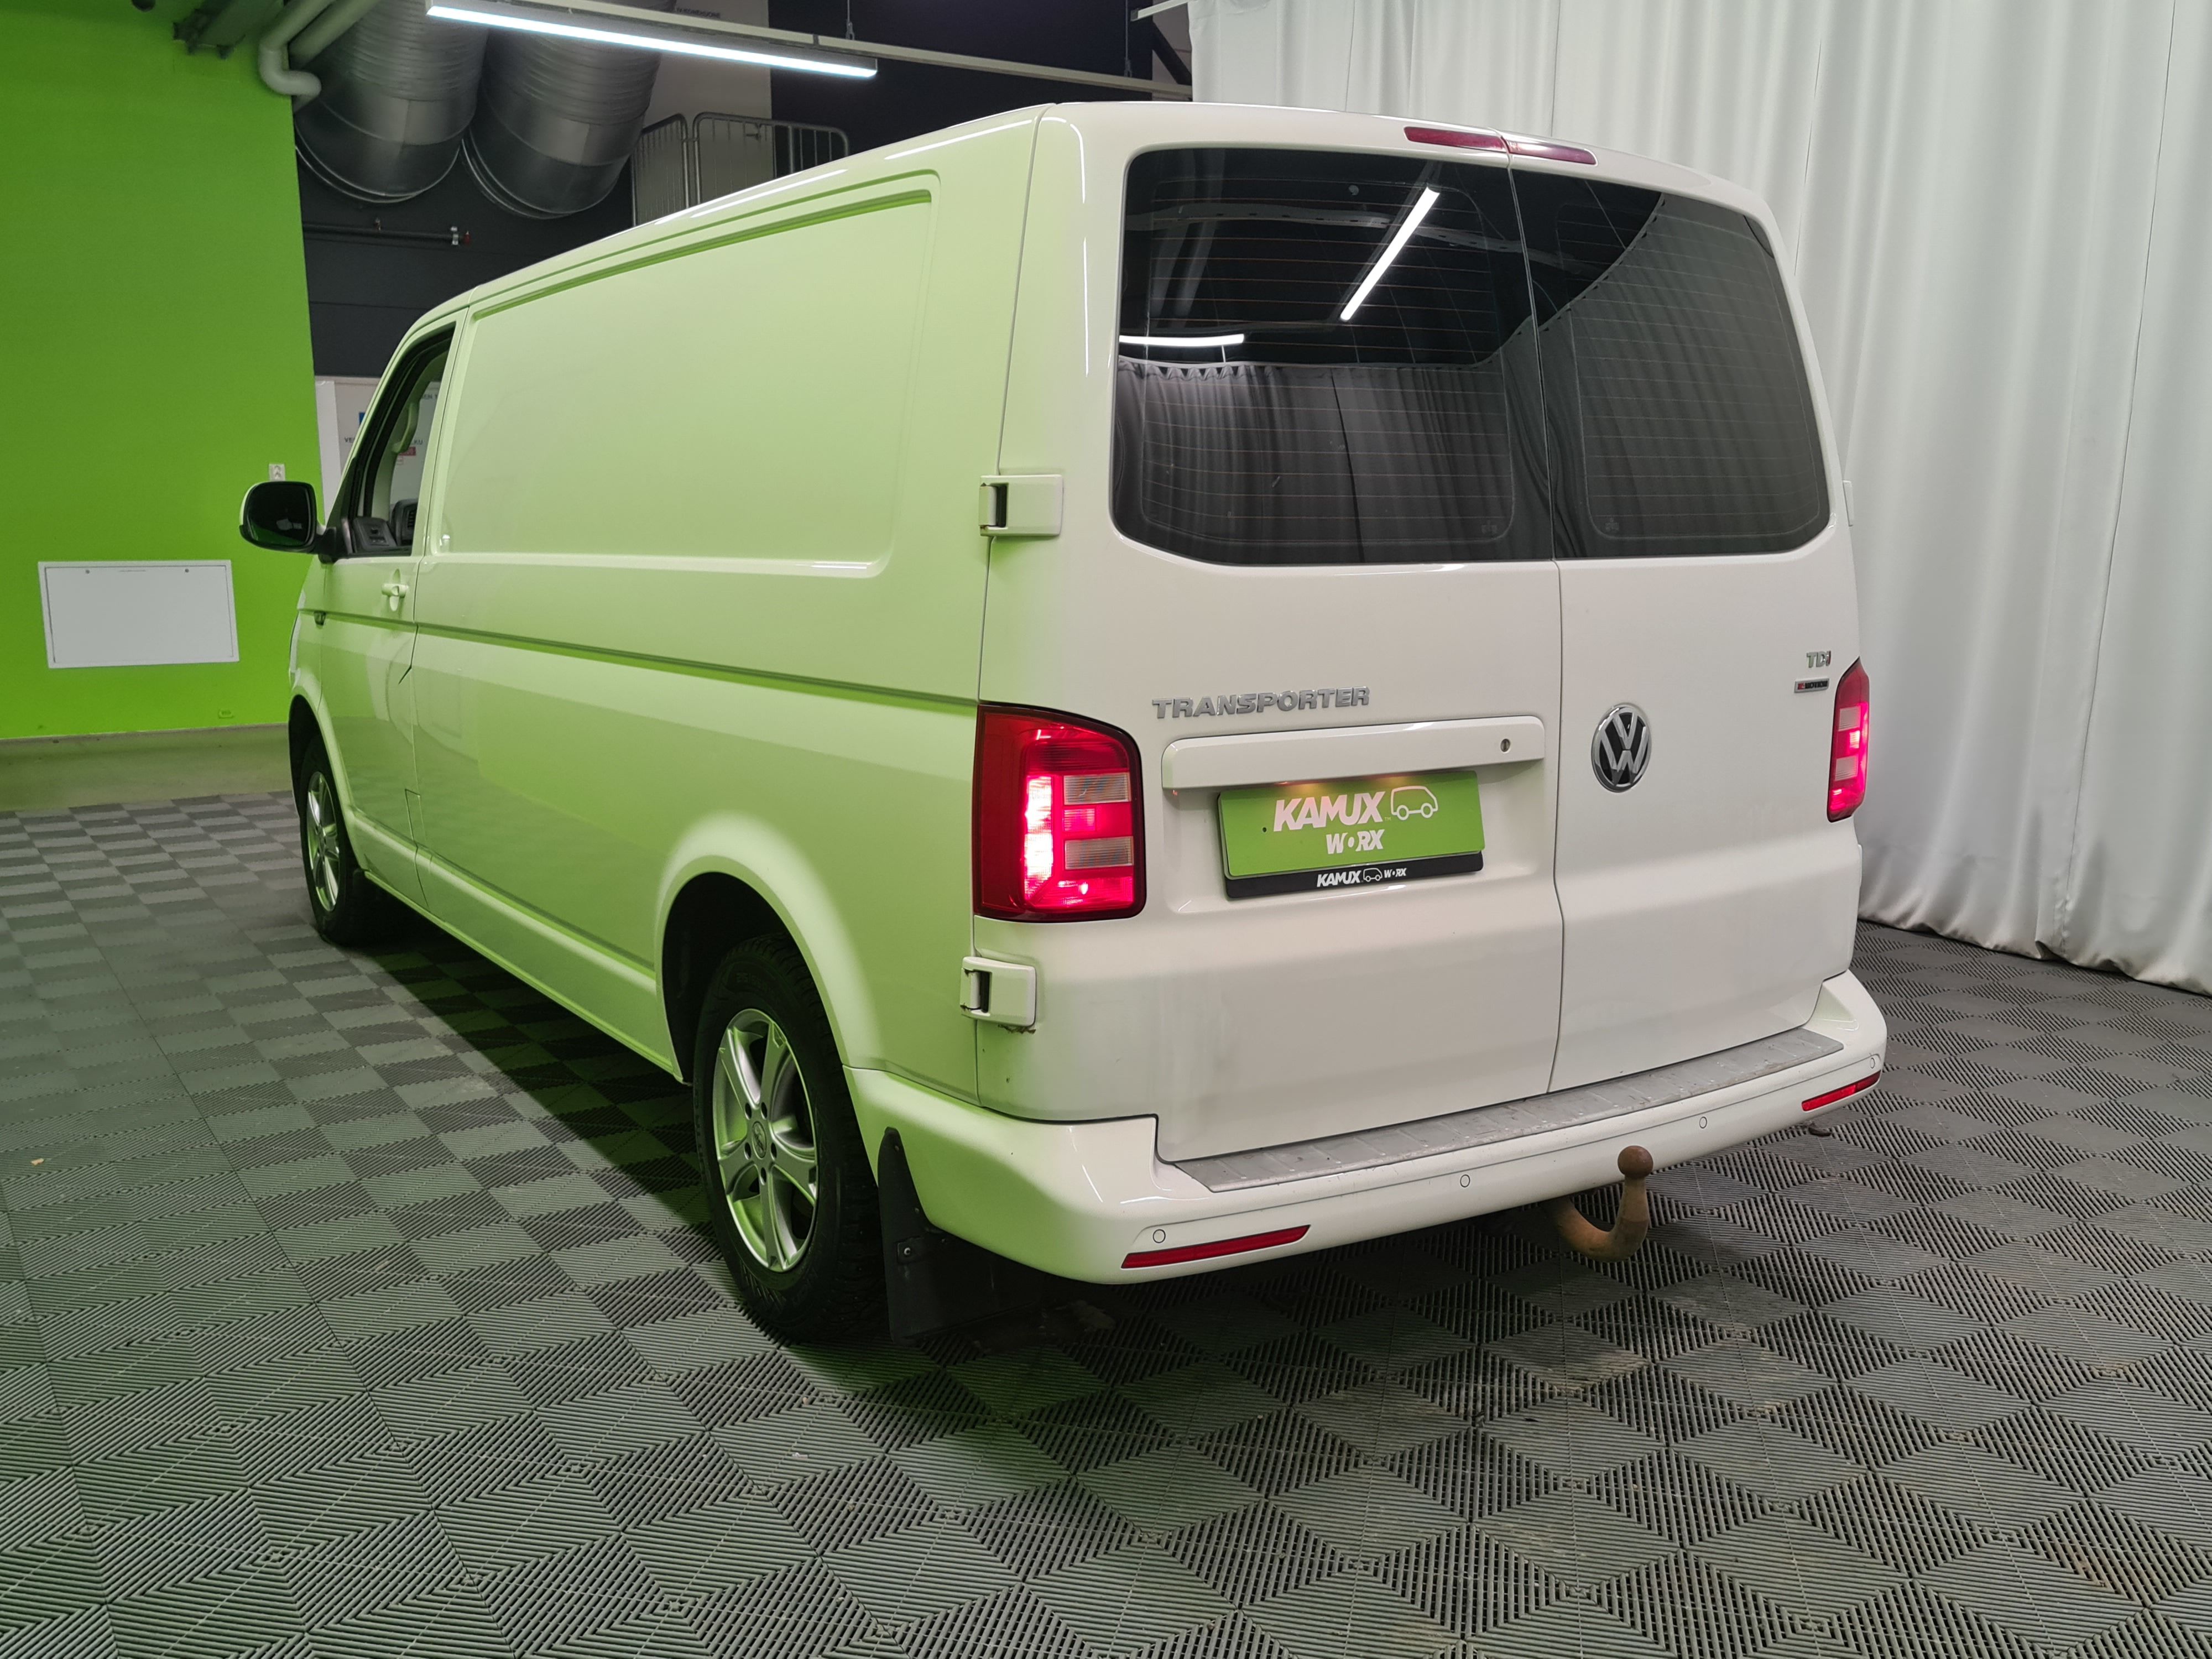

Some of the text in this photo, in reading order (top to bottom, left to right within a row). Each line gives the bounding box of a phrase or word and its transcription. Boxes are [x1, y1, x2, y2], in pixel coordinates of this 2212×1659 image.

[1152, 686, 1370, 719] TRANSPORTER
[1274, 791, 1385, 832] KAMUX
[1317, 870, 1362, 888] KAMUX
